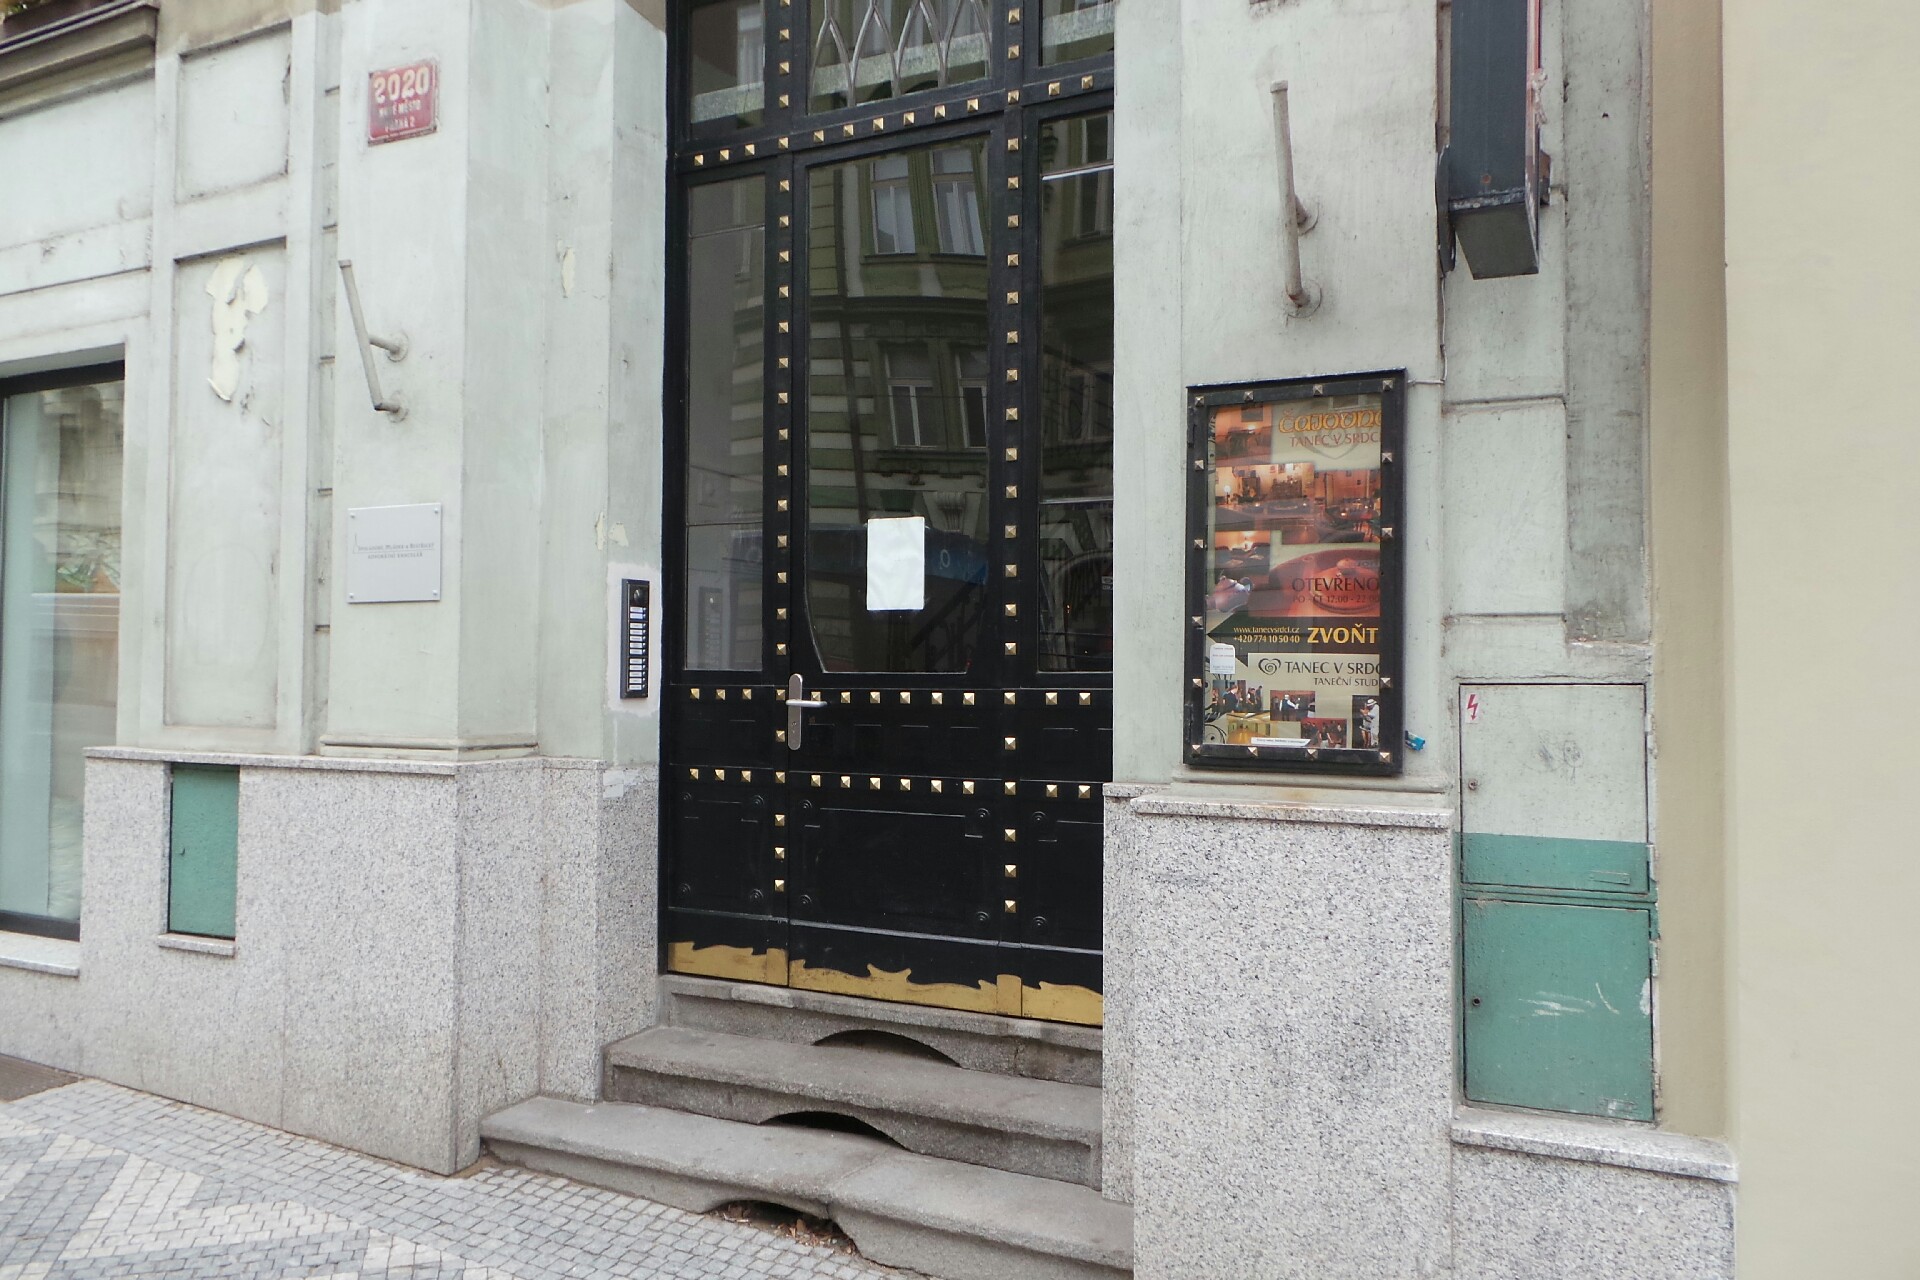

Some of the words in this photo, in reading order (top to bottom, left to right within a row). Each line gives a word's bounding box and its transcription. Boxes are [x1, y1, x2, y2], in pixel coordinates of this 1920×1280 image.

[373, 66, 430, 103] 2020
[1289, 434, 1330, 447] TANEC
[1333, 433, 1343, 445] V
[1292, 573, 1379, 592] OTEVŘENO
[1233, 626, 1300, 634] www.tanecvsrdci.cz
[1307, 623, 1379, 644] ZVOŇT
[1233, 634, 1253, 643] +420
[1254, 634, 1267, 643] 774
[1269, 635, 1278, 643] 10
[1278, 635, 1289, 643] 50
[1289, 635, 1300, 644] 40
[1285, 661, 1330, 673] TANEC
[1333, 662, 1343, 674] V
[1314, 676, 1352, 686] TANEČNÍ
[1354, 678, 1379, 687] STUD
